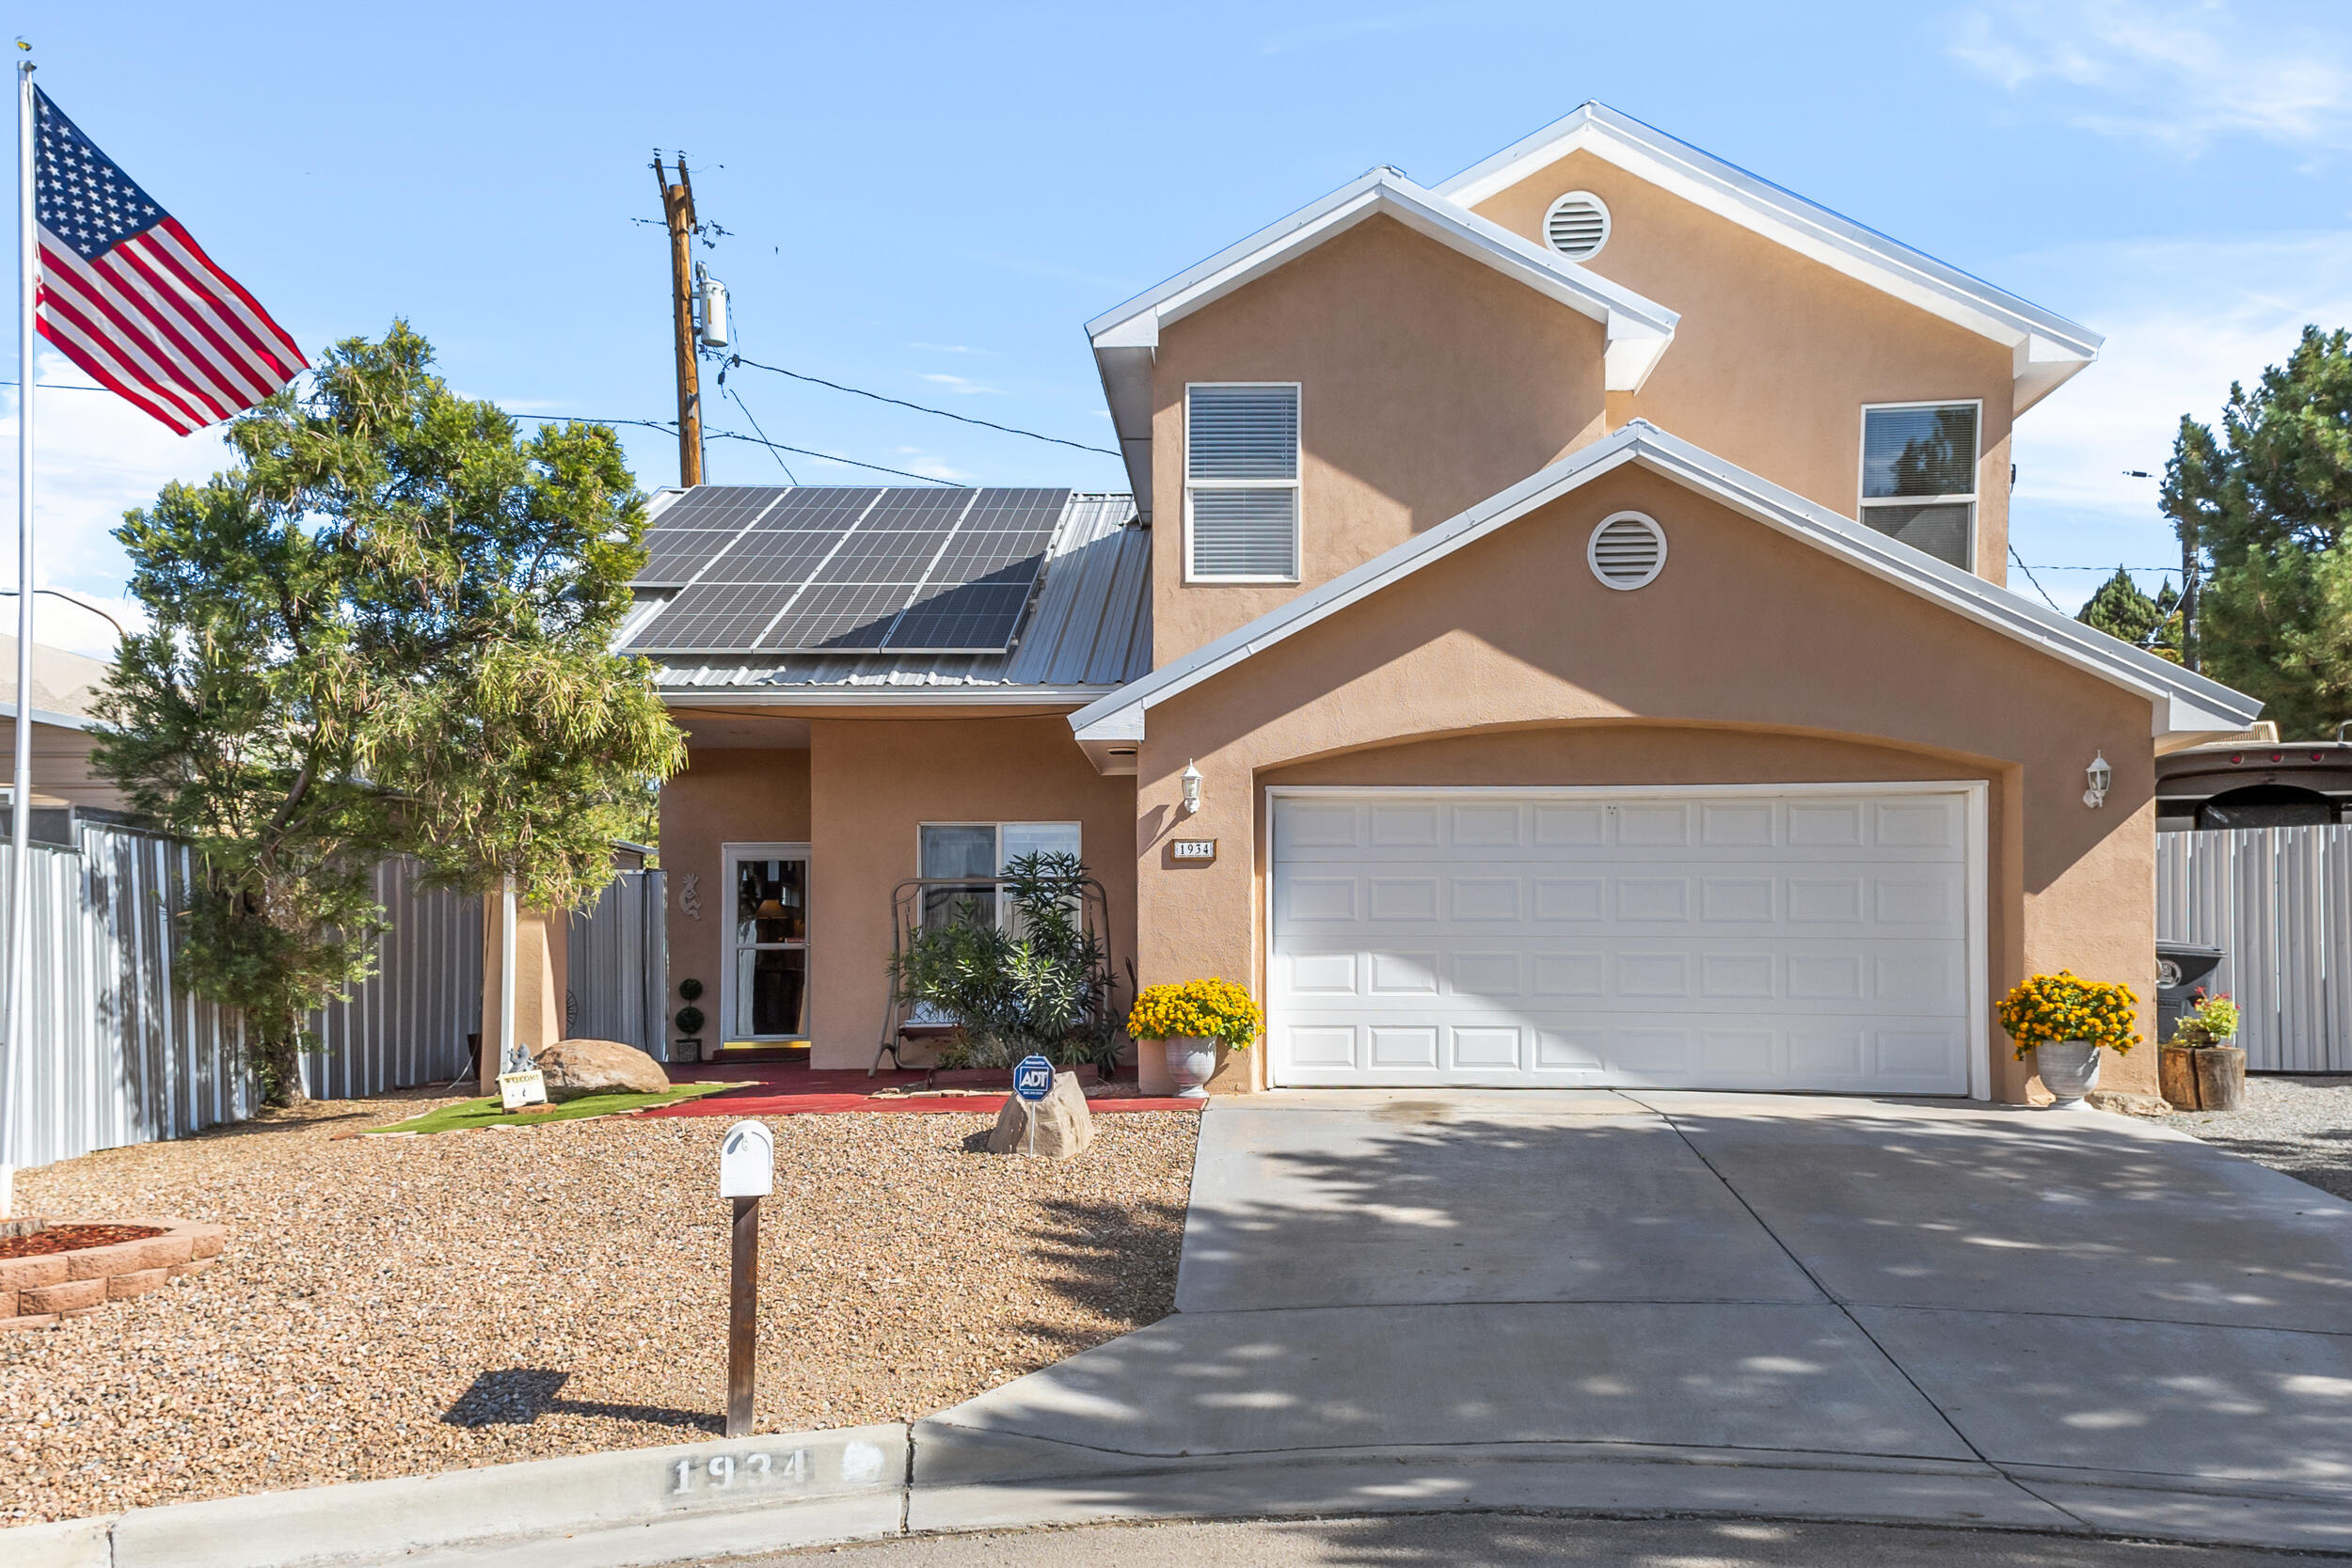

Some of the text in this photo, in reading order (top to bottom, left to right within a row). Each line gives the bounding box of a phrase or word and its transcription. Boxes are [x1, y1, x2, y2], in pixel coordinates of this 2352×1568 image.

[1180, 844, 1209, 855] 1934
[1021, 1070, 1048, 1087] ADT
[673, 1449, 808, 1495] 1934
